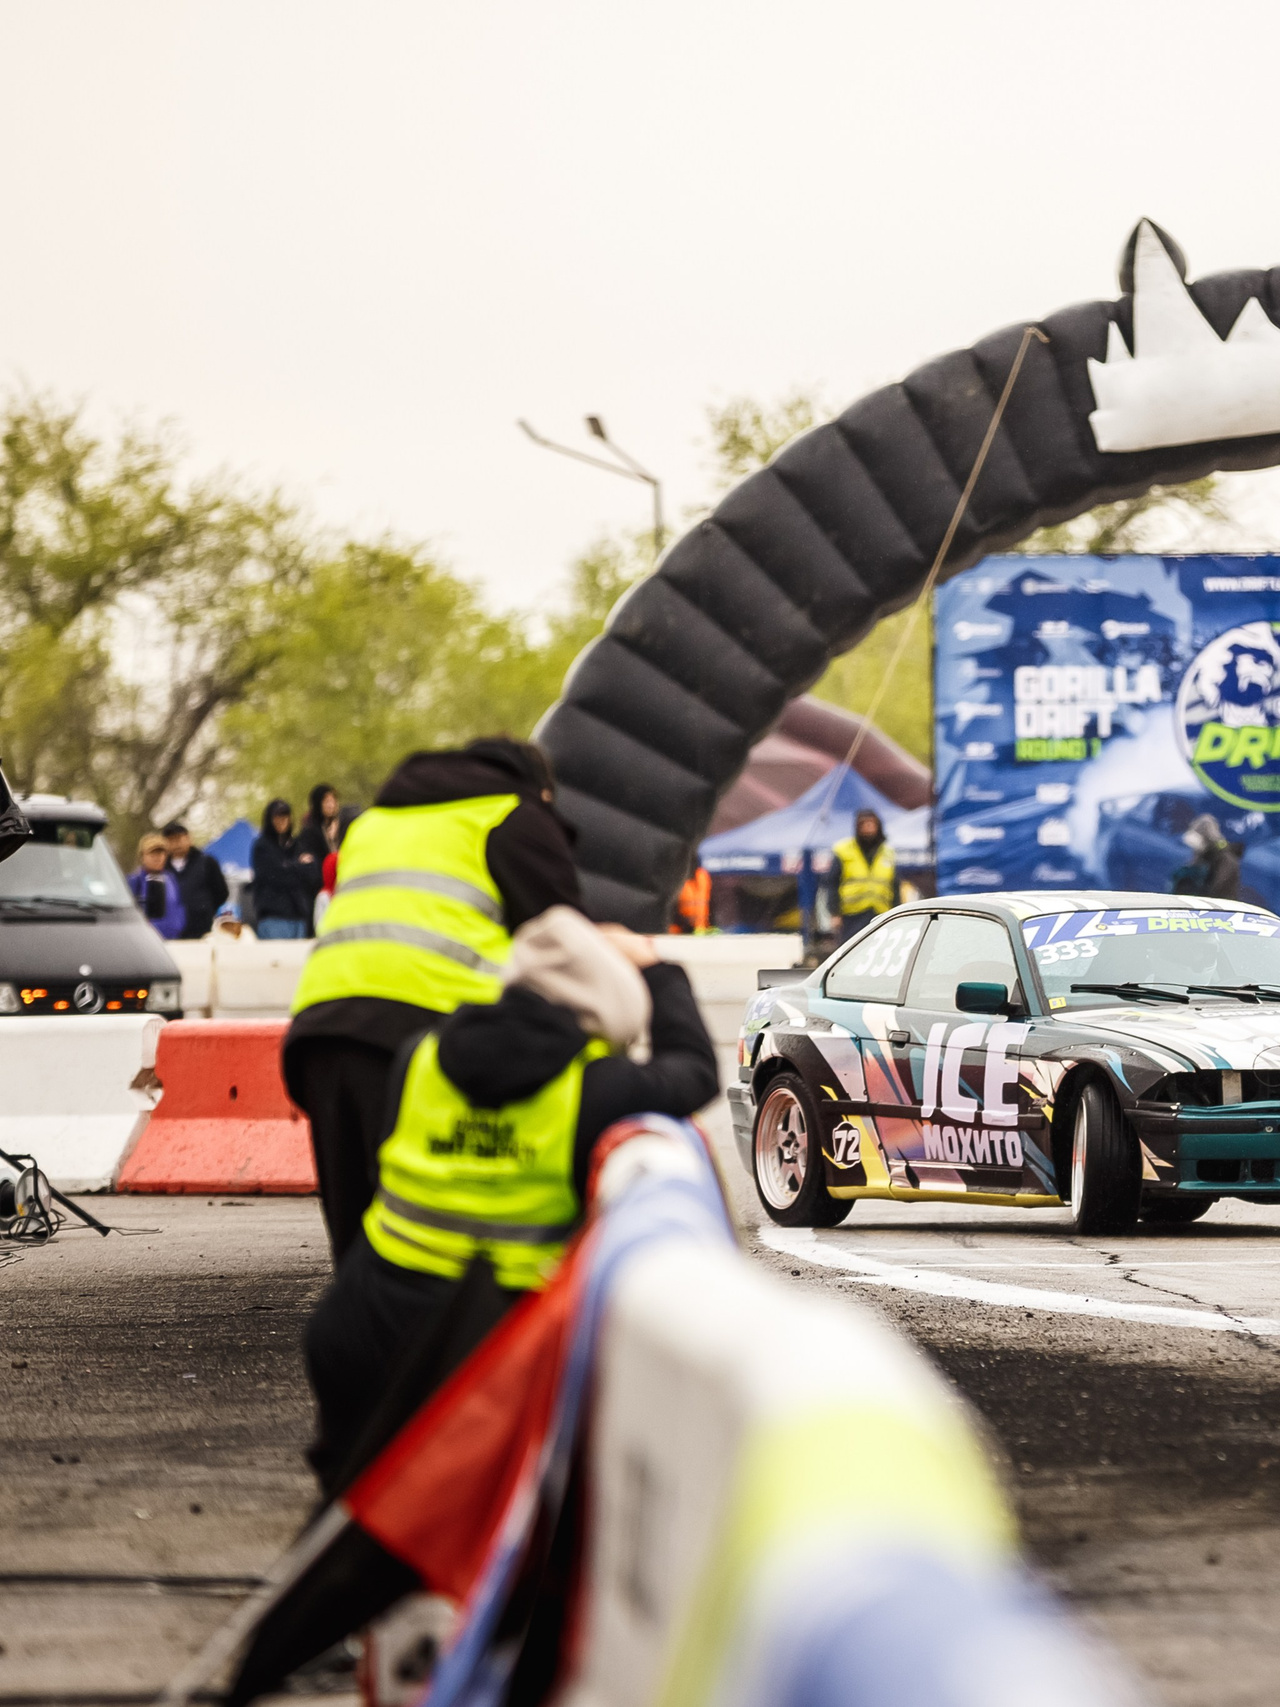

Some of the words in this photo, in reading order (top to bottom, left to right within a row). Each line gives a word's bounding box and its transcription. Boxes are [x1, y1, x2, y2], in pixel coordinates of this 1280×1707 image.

[1014, 665, 1162, 703] GORILLA
[1014, 702, 1118, 738] DRIFT
[1146, 917, 1235, 934] DRIFT
[855, 928, 921, 977] 333
[1035, 938, 1099, 965] 333
[921, 1022, 1034, 1127] ICE
[834, 1129, 860, 1162] 72
[922, 1124, 1024, 1167] МОХИТО
